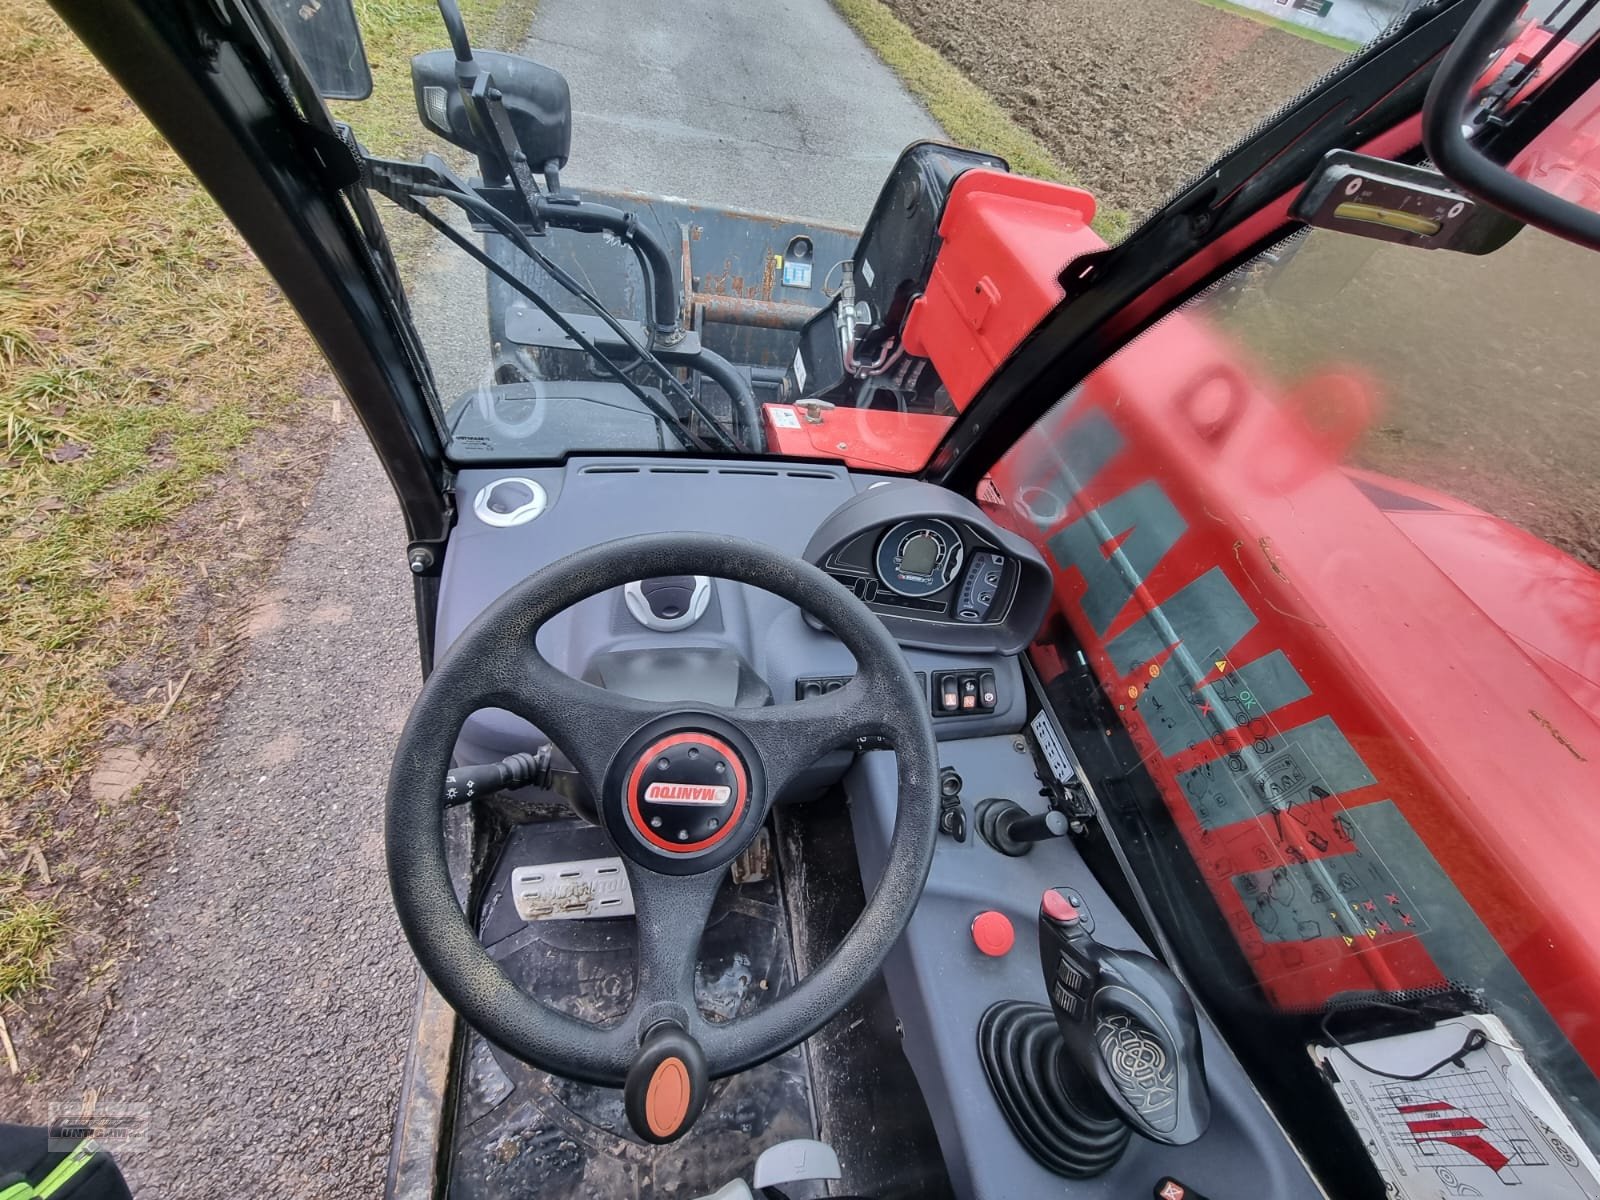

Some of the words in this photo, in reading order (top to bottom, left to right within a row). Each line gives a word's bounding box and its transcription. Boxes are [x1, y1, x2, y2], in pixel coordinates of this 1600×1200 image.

[1239, 691, 1257, 709] OK
[650, 785, 716, 801] MANITOU
[1551, 1138, 1575, 1163] 625
